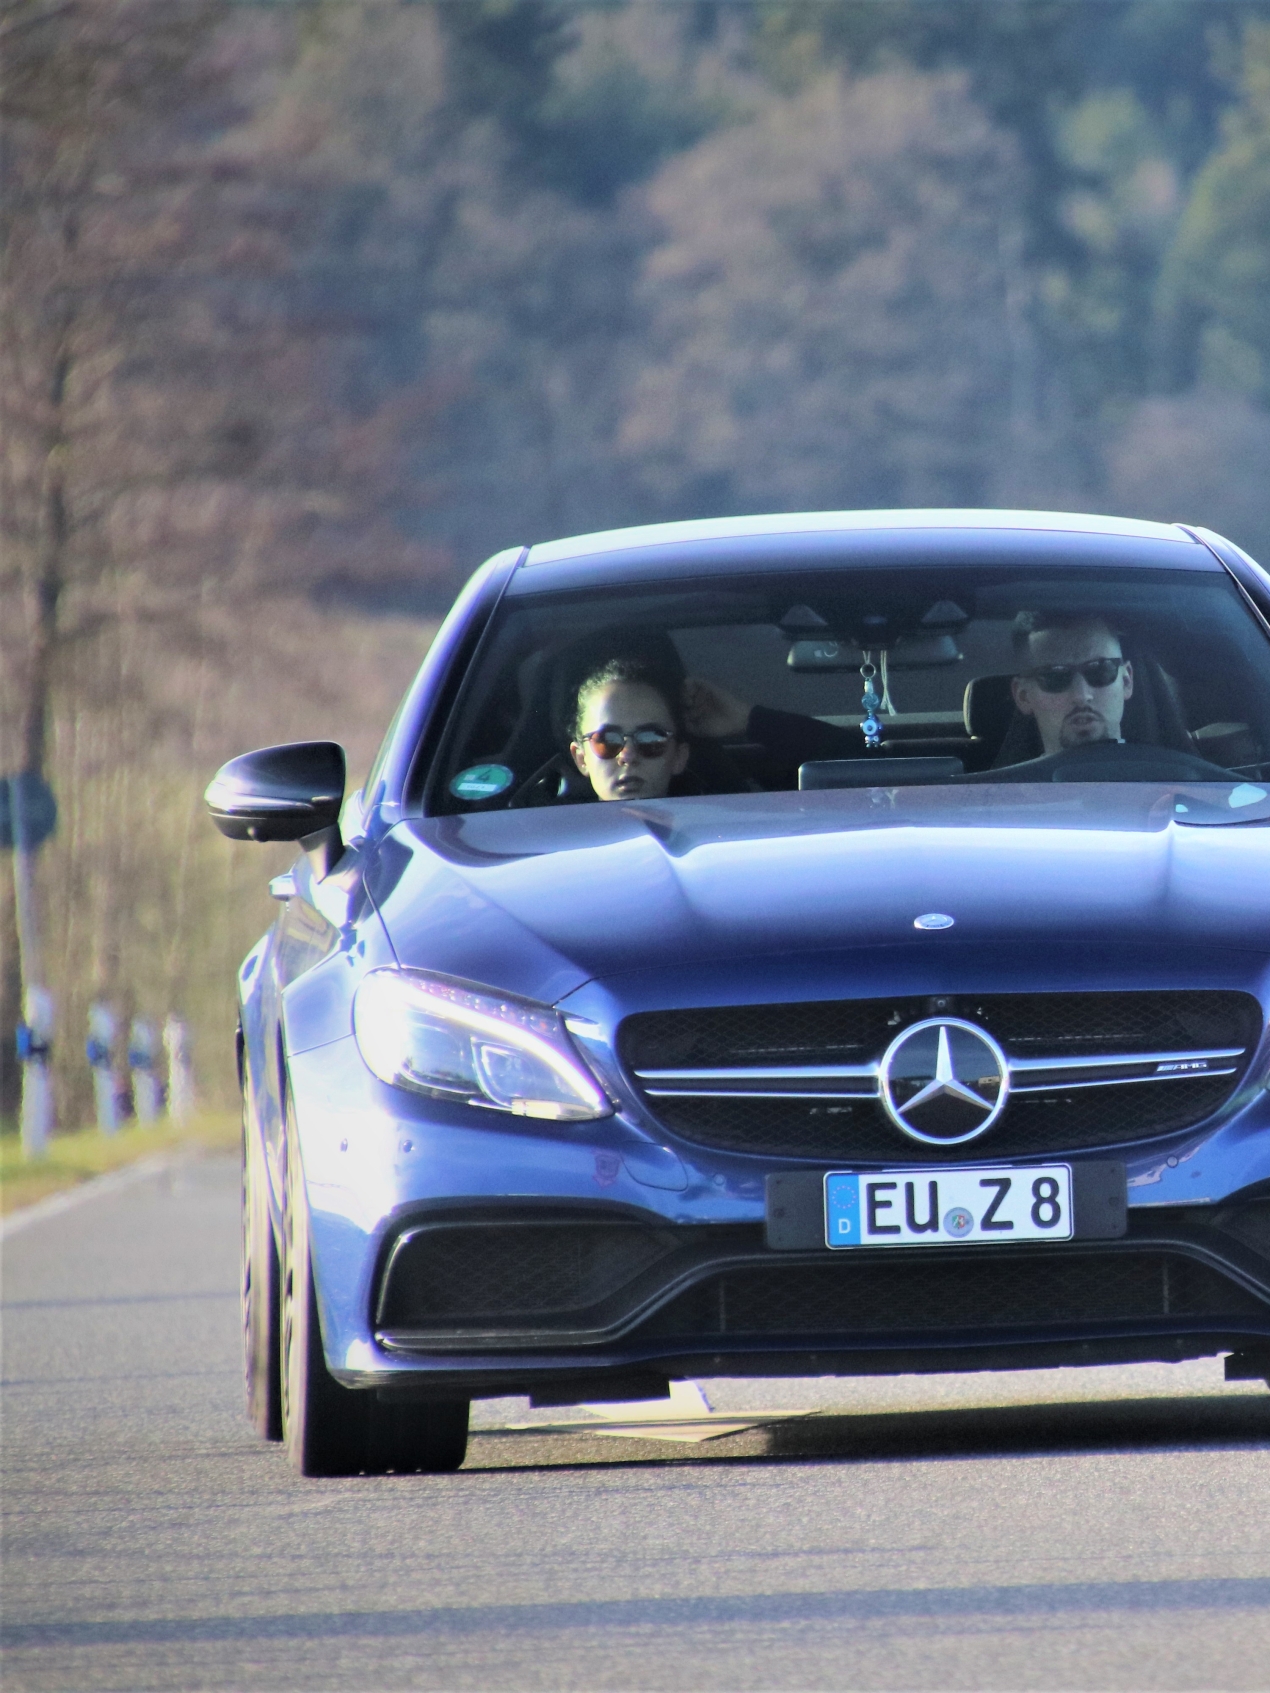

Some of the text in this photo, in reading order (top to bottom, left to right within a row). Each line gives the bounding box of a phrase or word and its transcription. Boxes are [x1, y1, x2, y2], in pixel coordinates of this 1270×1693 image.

[866, 1176, 1061, 1235] EU Z 8
[838, 1218, 851, 1234] D
